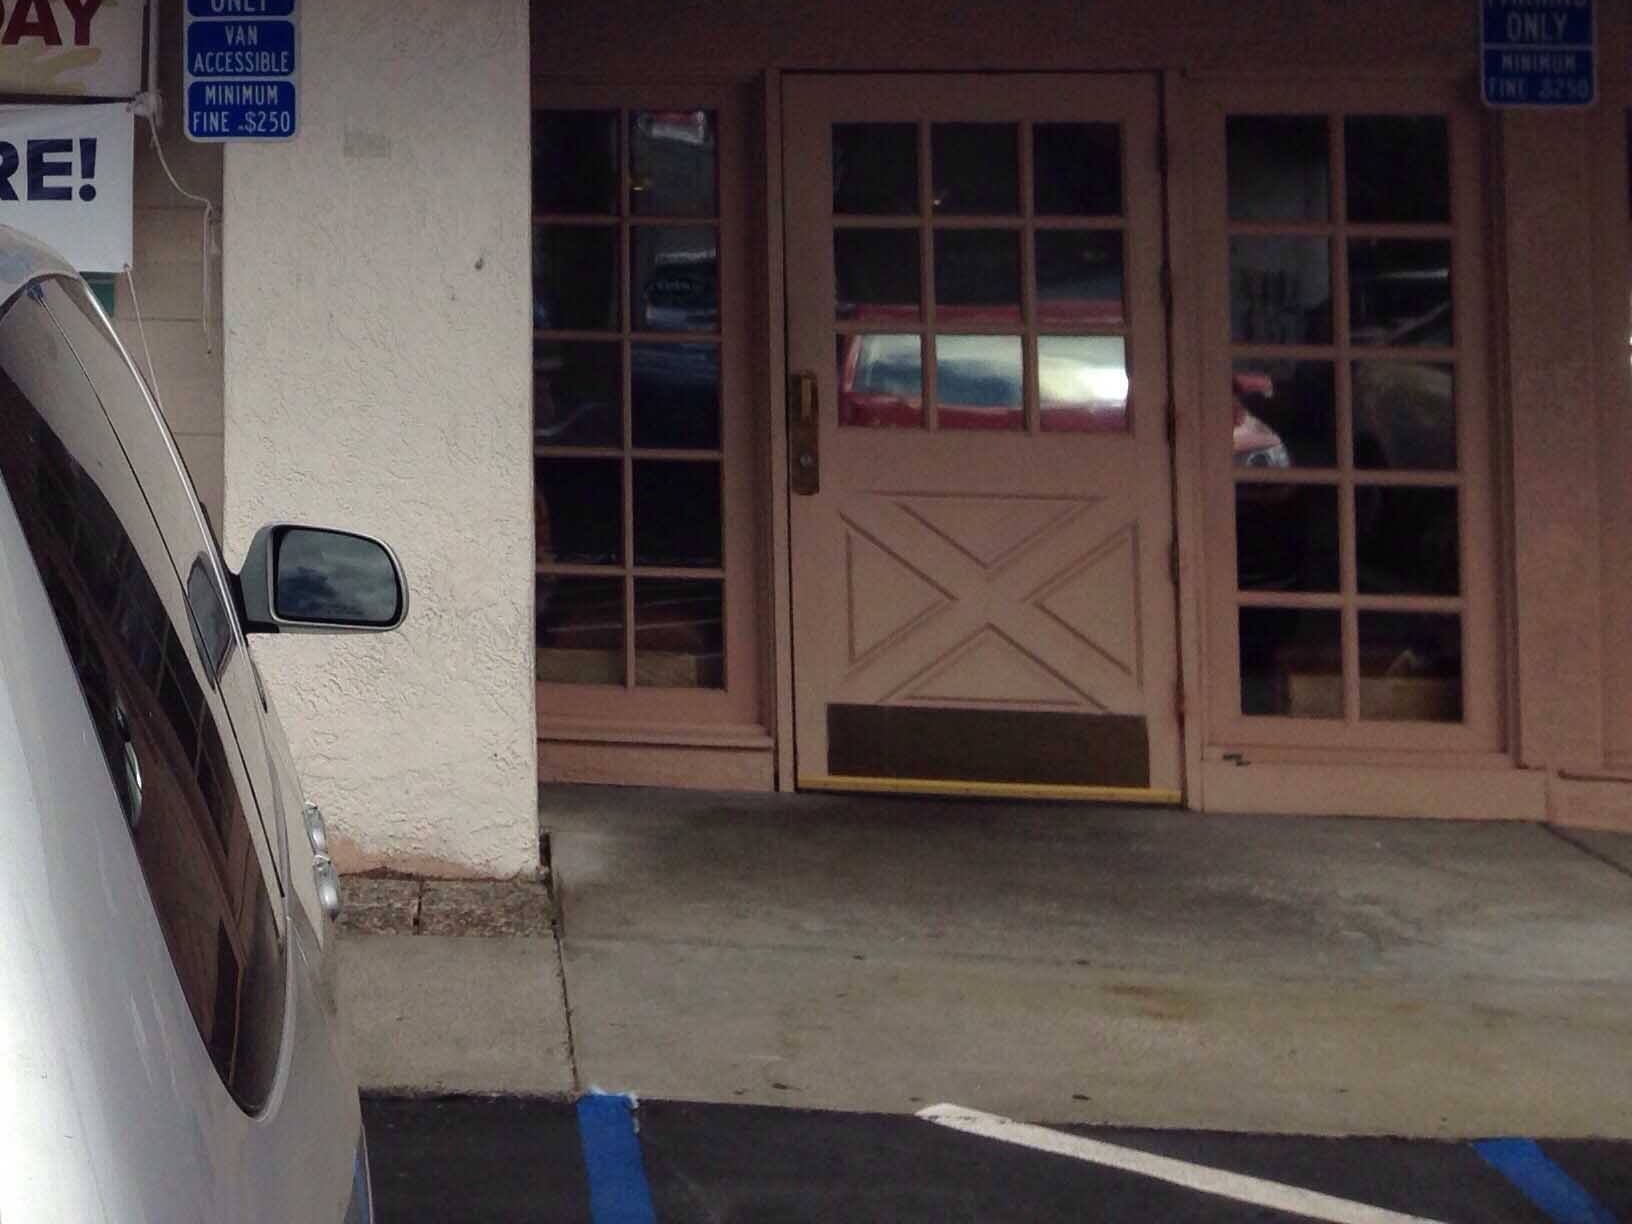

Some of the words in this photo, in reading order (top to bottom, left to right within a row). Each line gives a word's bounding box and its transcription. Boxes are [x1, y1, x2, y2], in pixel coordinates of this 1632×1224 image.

[224, 24, 259, 46] VAN
[1506, 11, 1569, 42] ONLY
[192, 51, 289, 73] ACCESSIBLE
[205, 84, 279, 106] MINIMUM
[192, 111, 230, 133] FINE
[244, 110, 290, 134] $250
